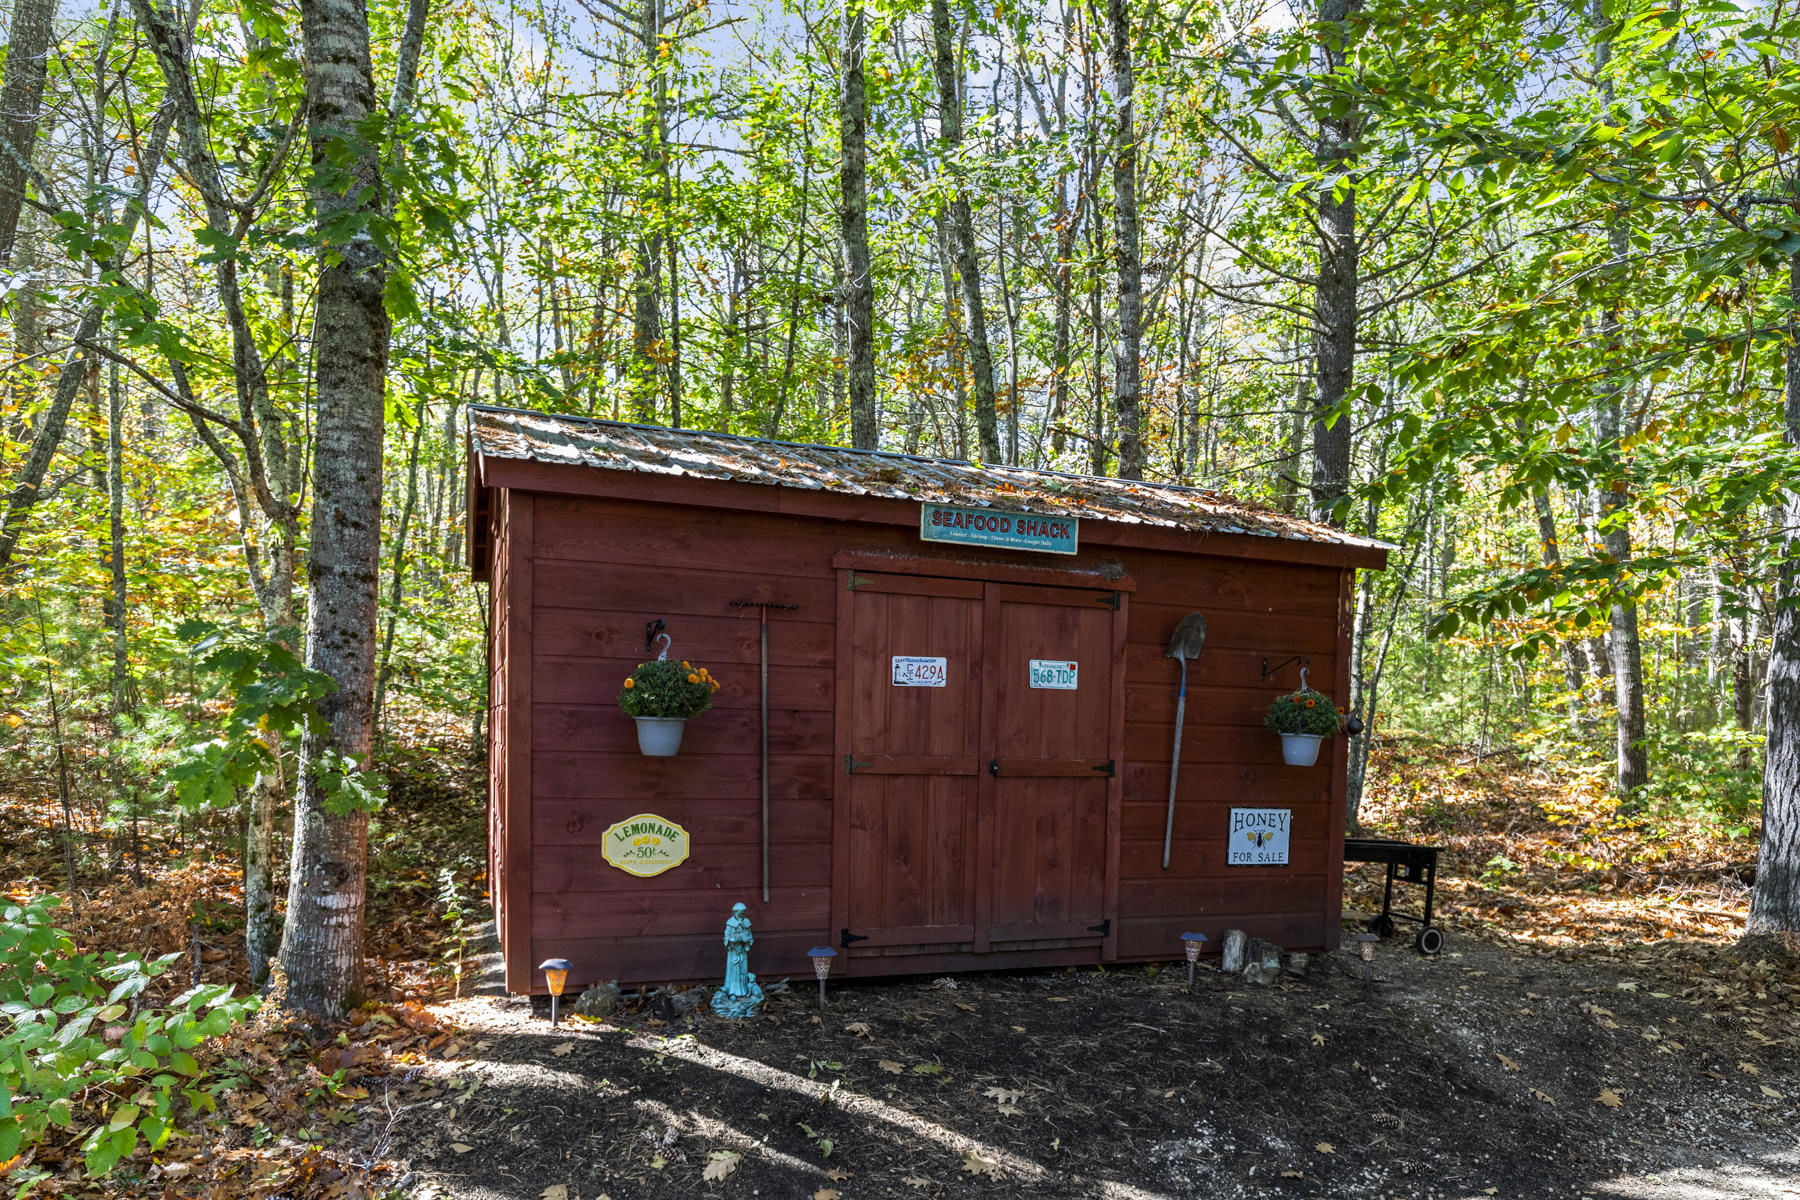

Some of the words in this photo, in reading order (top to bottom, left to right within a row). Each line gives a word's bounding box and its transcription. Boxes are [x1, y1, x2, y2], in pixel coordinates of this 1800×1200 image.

[932, 511, 1011, 533] SEAFOOD
[1016, 519, 1070, 539] SHACK
[915, 665, 943, 679] 429A
[614, 822, 679, 842] LEMONADE
[1233, 812, 1288, 833] HONEY
[1233, 852, 1252, 862] FOR
[1257, 852, 1284, 862] SALE
